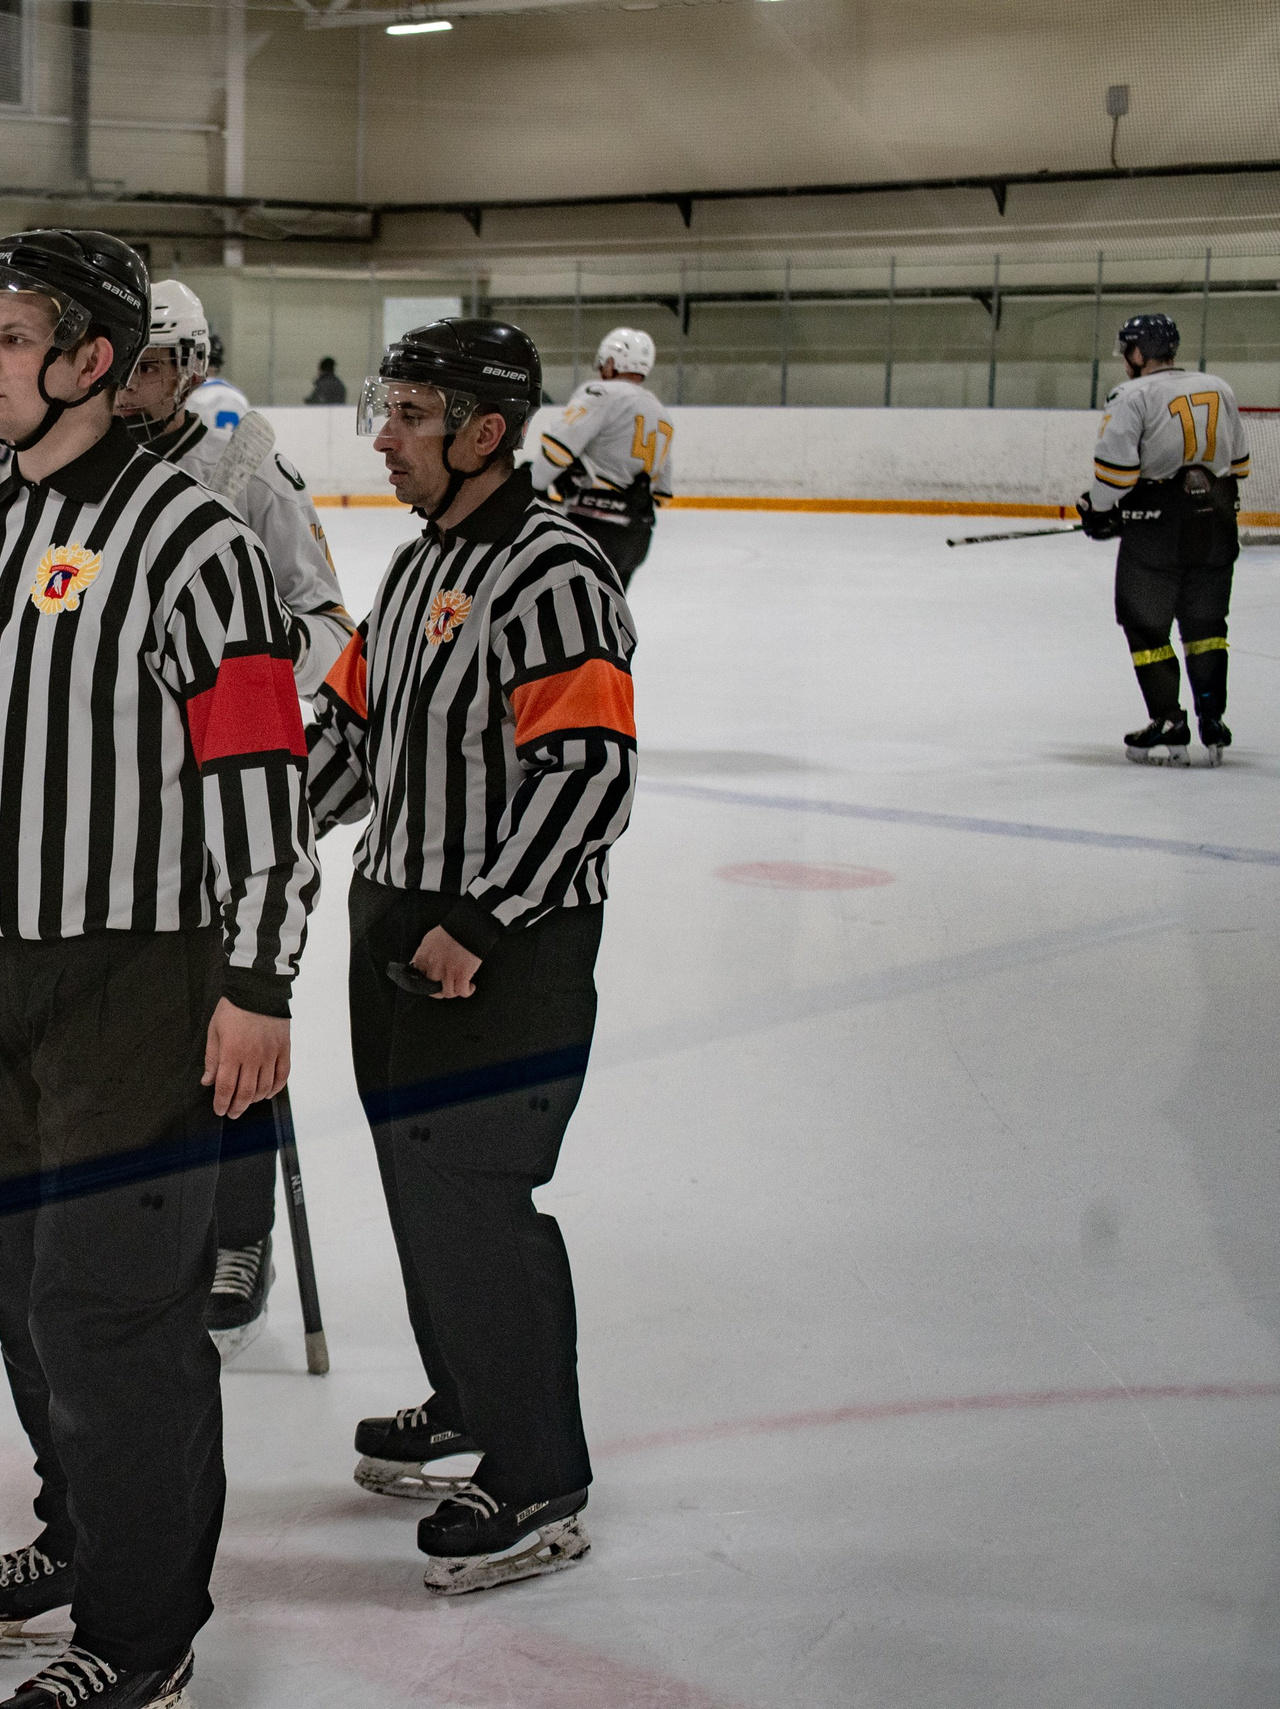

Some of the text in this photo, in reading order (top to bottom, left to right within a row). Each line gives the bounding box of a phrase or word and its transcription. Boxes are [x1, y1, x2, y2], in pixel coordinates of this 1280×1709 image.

[102, 281, 141, 309] BAUER
[482, 366, 527, 382] BAUER
[630, 414, 674, 482] 47
[1168, 391, 1220, 462] 17
